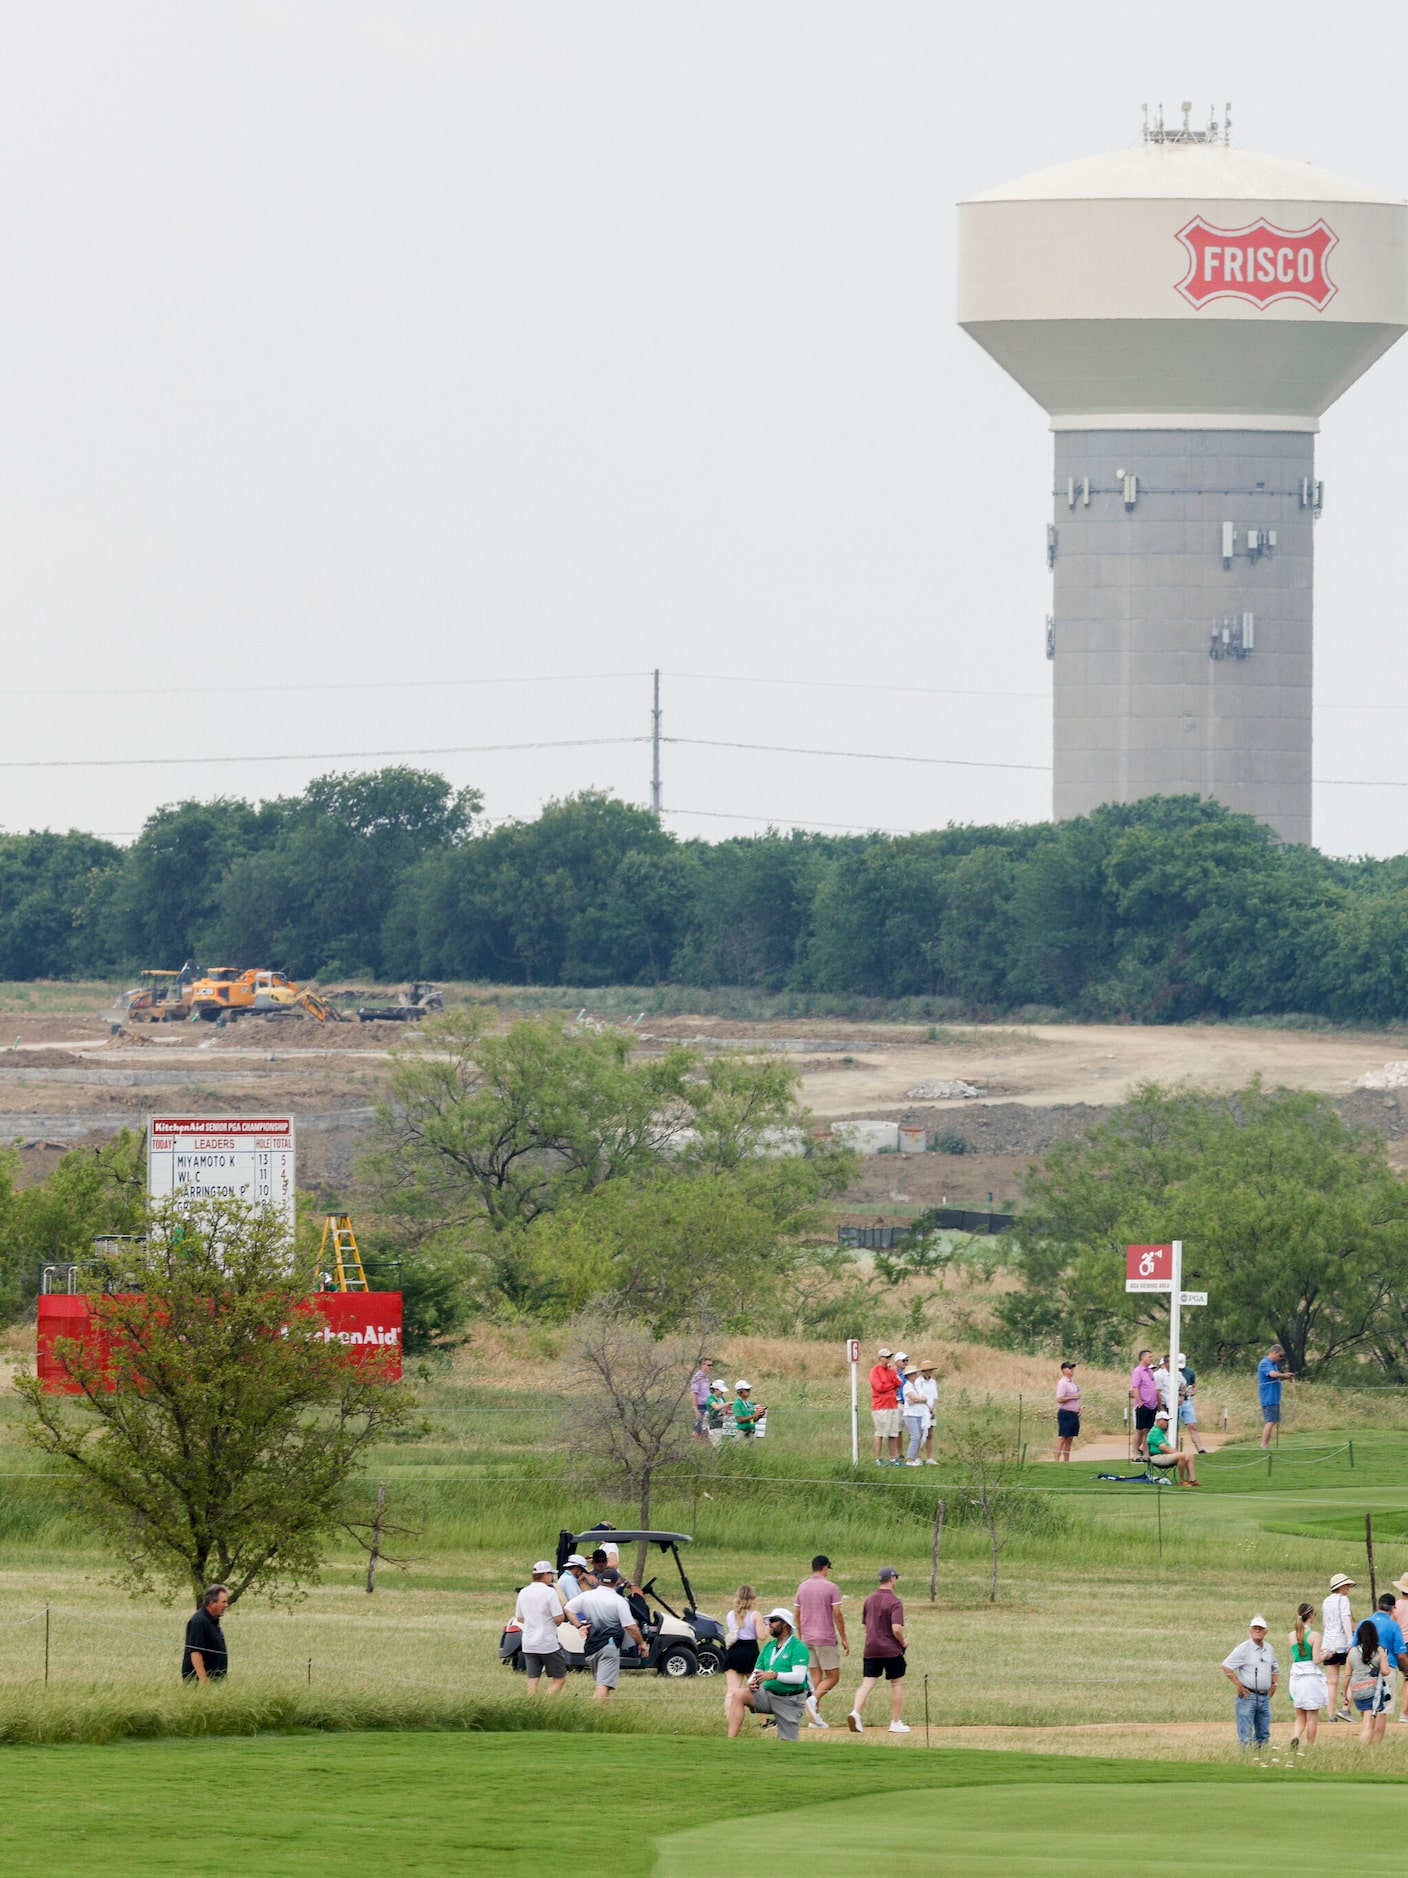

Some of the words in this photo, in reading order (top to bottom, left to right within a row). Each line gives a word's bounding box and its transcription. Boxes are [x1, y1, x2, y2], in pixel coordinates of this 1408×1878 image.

[1204, 246, 1315, 283] FRISCO
[155, 1122, 205, 1132] KitchenAid
[205, 1122, 227, 1132] SENIOR
[228, 1122, 241, 1132] PGA
[241, 1122, 288, 1132] CHAMPIONSHIP
[152, 1139, 171, 1149] TODAY
[194, 1138, 235, 1149] LEADERS
[256, 1138, 270, 1149] HOLE
[272, 1138, 292, 1149] TOTAL
[177, 1155, 225, 1168] MIYAMOTO
[229, 1155, 235, 1167] K
[258, 1153, 268, 1166] 13
[281, 1154, 287, 1166] 5
[195, 1171, 200, 1183] C
[259, 1168, 267, 1180] 11
[280, 1169, 286, 1181] 4
[178, 1185, 235, 1198] ARRINGTON
[240, 1185, 246, 1196] P
[259, 1184, 269, 1196] 10
[853, 1342, 858, 1360] 6
